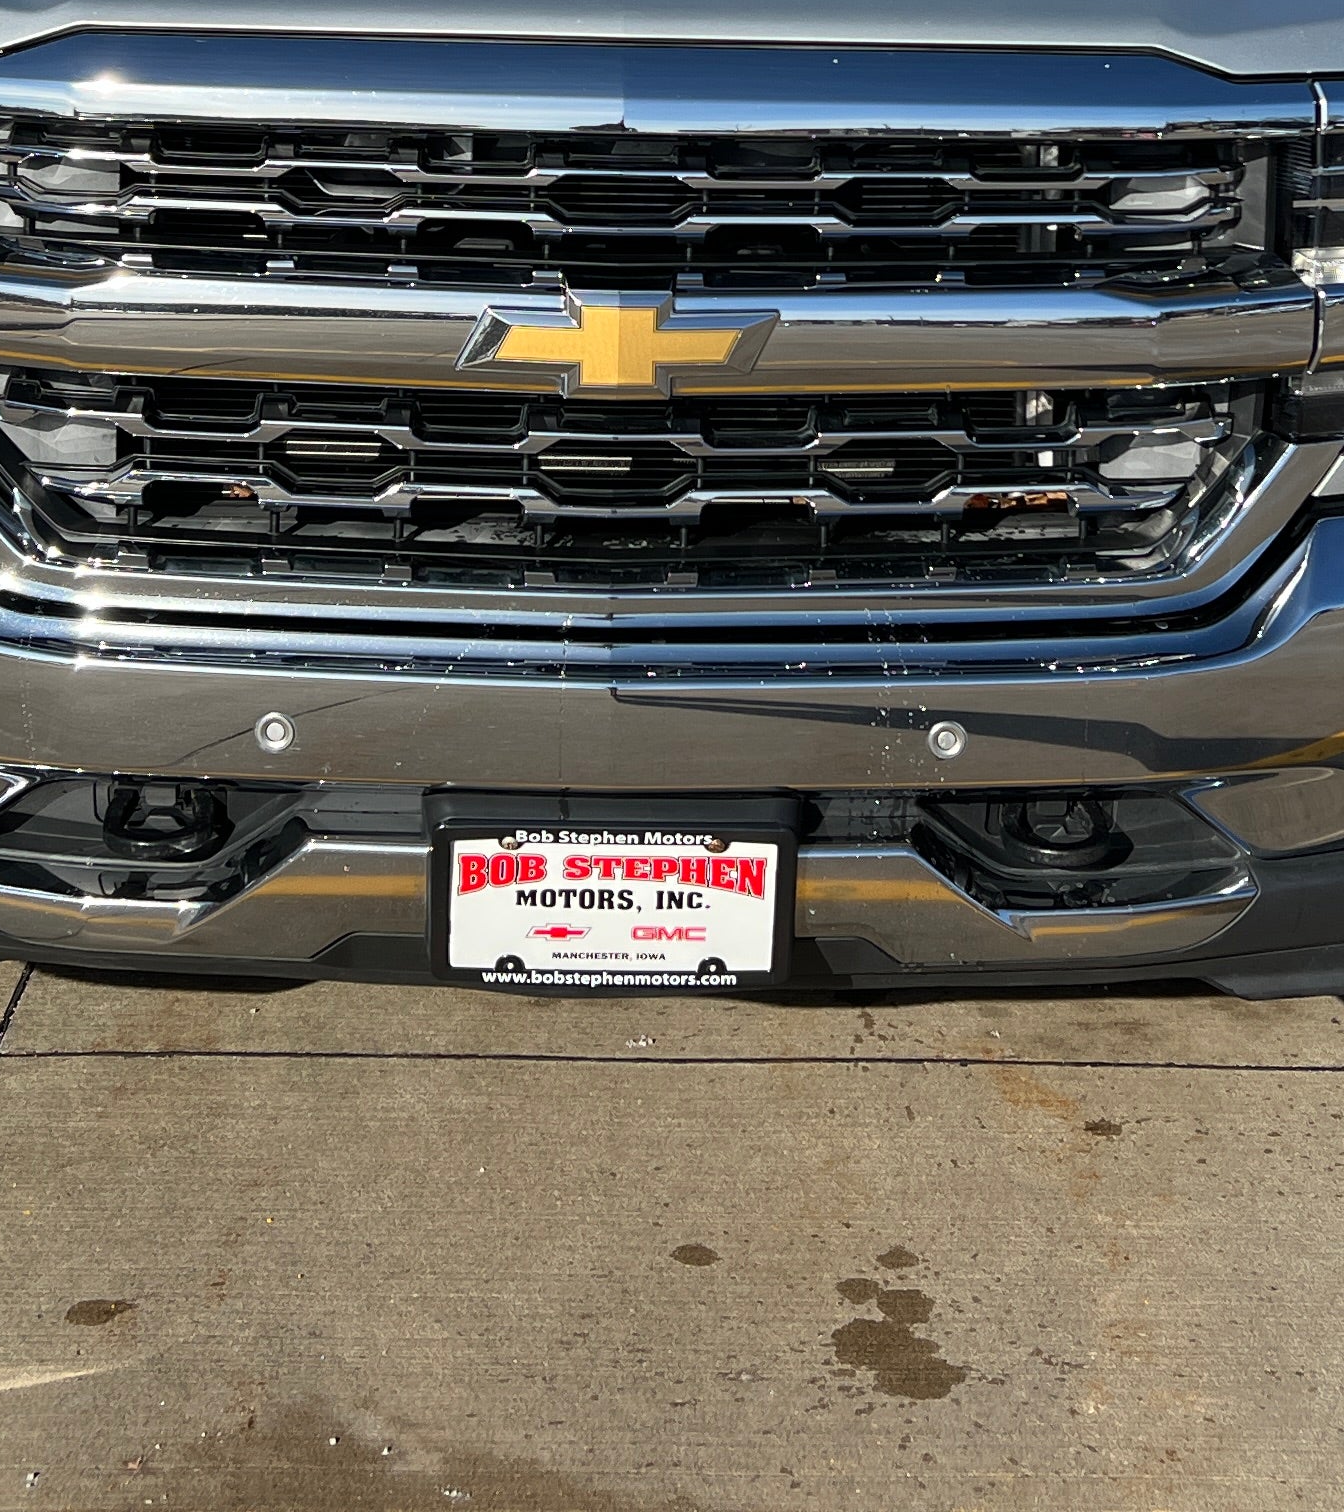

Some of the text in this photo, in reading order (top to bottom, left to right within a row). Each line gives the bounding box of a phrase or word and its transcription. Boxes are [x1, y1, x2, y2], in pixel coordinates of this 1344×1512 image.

[515, 829, 713, 847] Bob Stephen Motors
[457, 853, 767, 900] BOB STEPHEN
[515, 888, 711, 913] MOTORS, INC.
[631, 925, 707, 941] GMC
[551, 951, 666, 961] MANCHESTER, IOWA
[481, 970, 737, 987] www.bobstephenmotors.com
